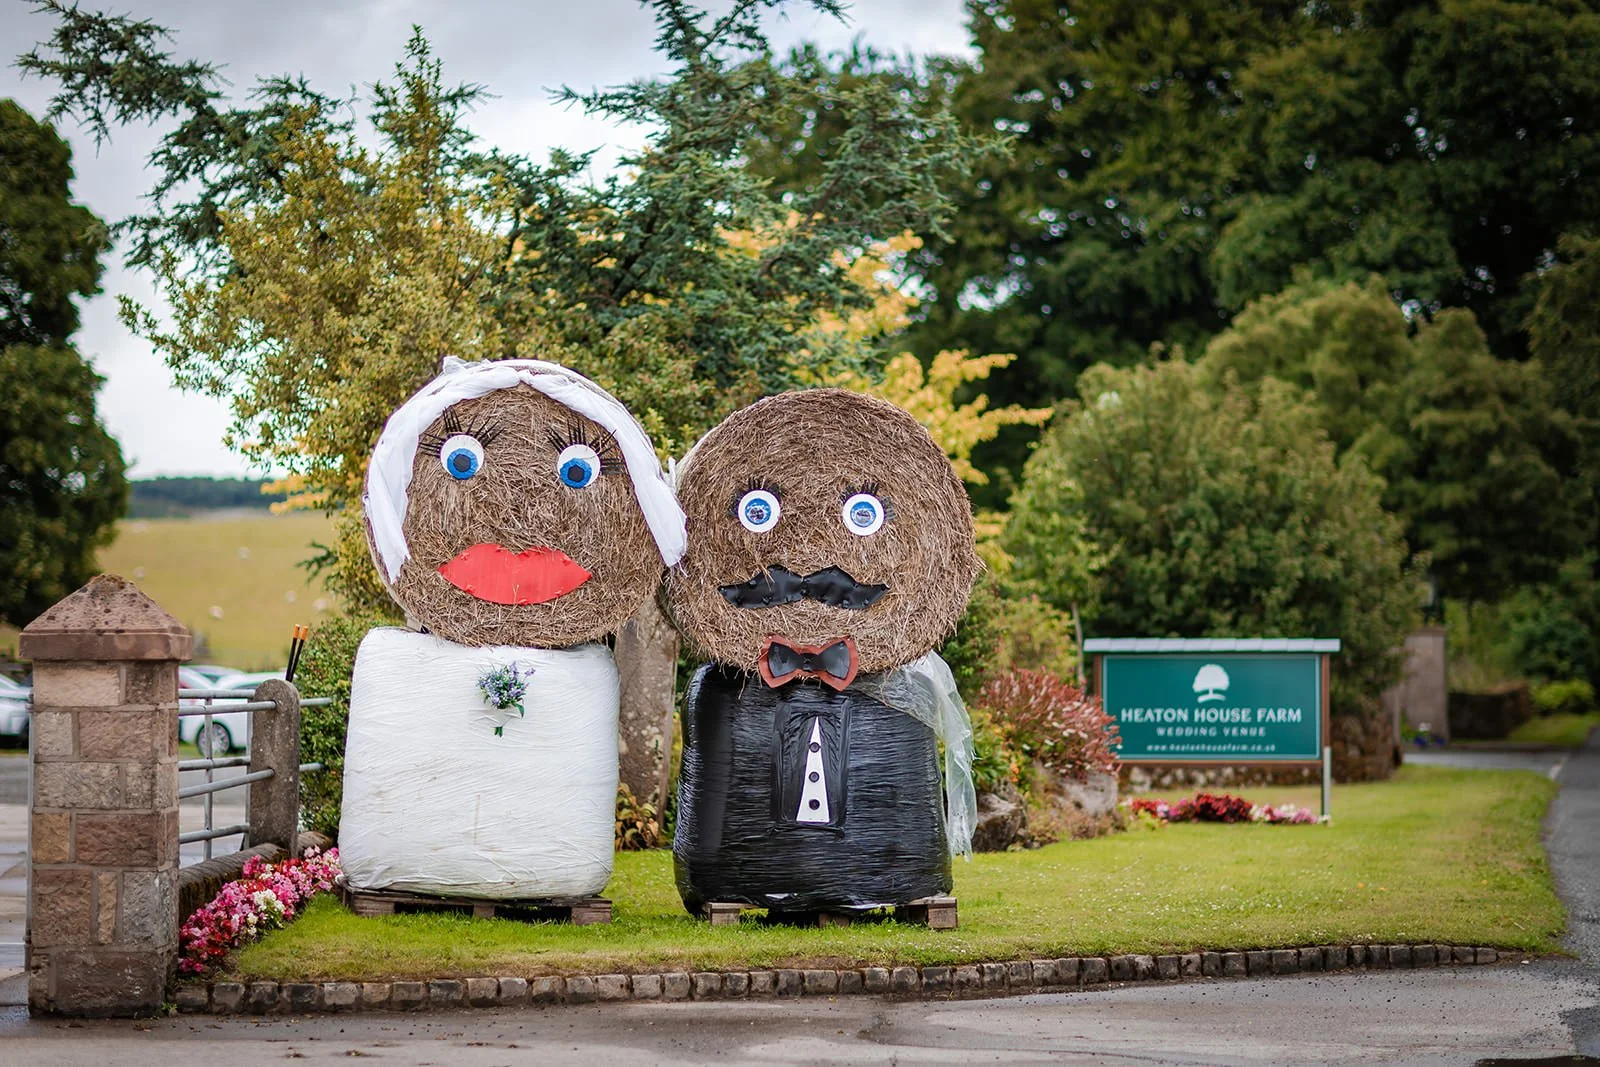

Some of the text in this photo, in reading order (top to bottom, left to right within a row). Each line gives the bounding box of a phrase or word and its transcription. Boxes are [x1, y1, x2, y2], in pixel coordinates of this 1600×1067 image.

[1121, 708, 1302, 722] HEATON HOUSE FARM
[1156, 727, 1266, 736] WEDDING VENUE
